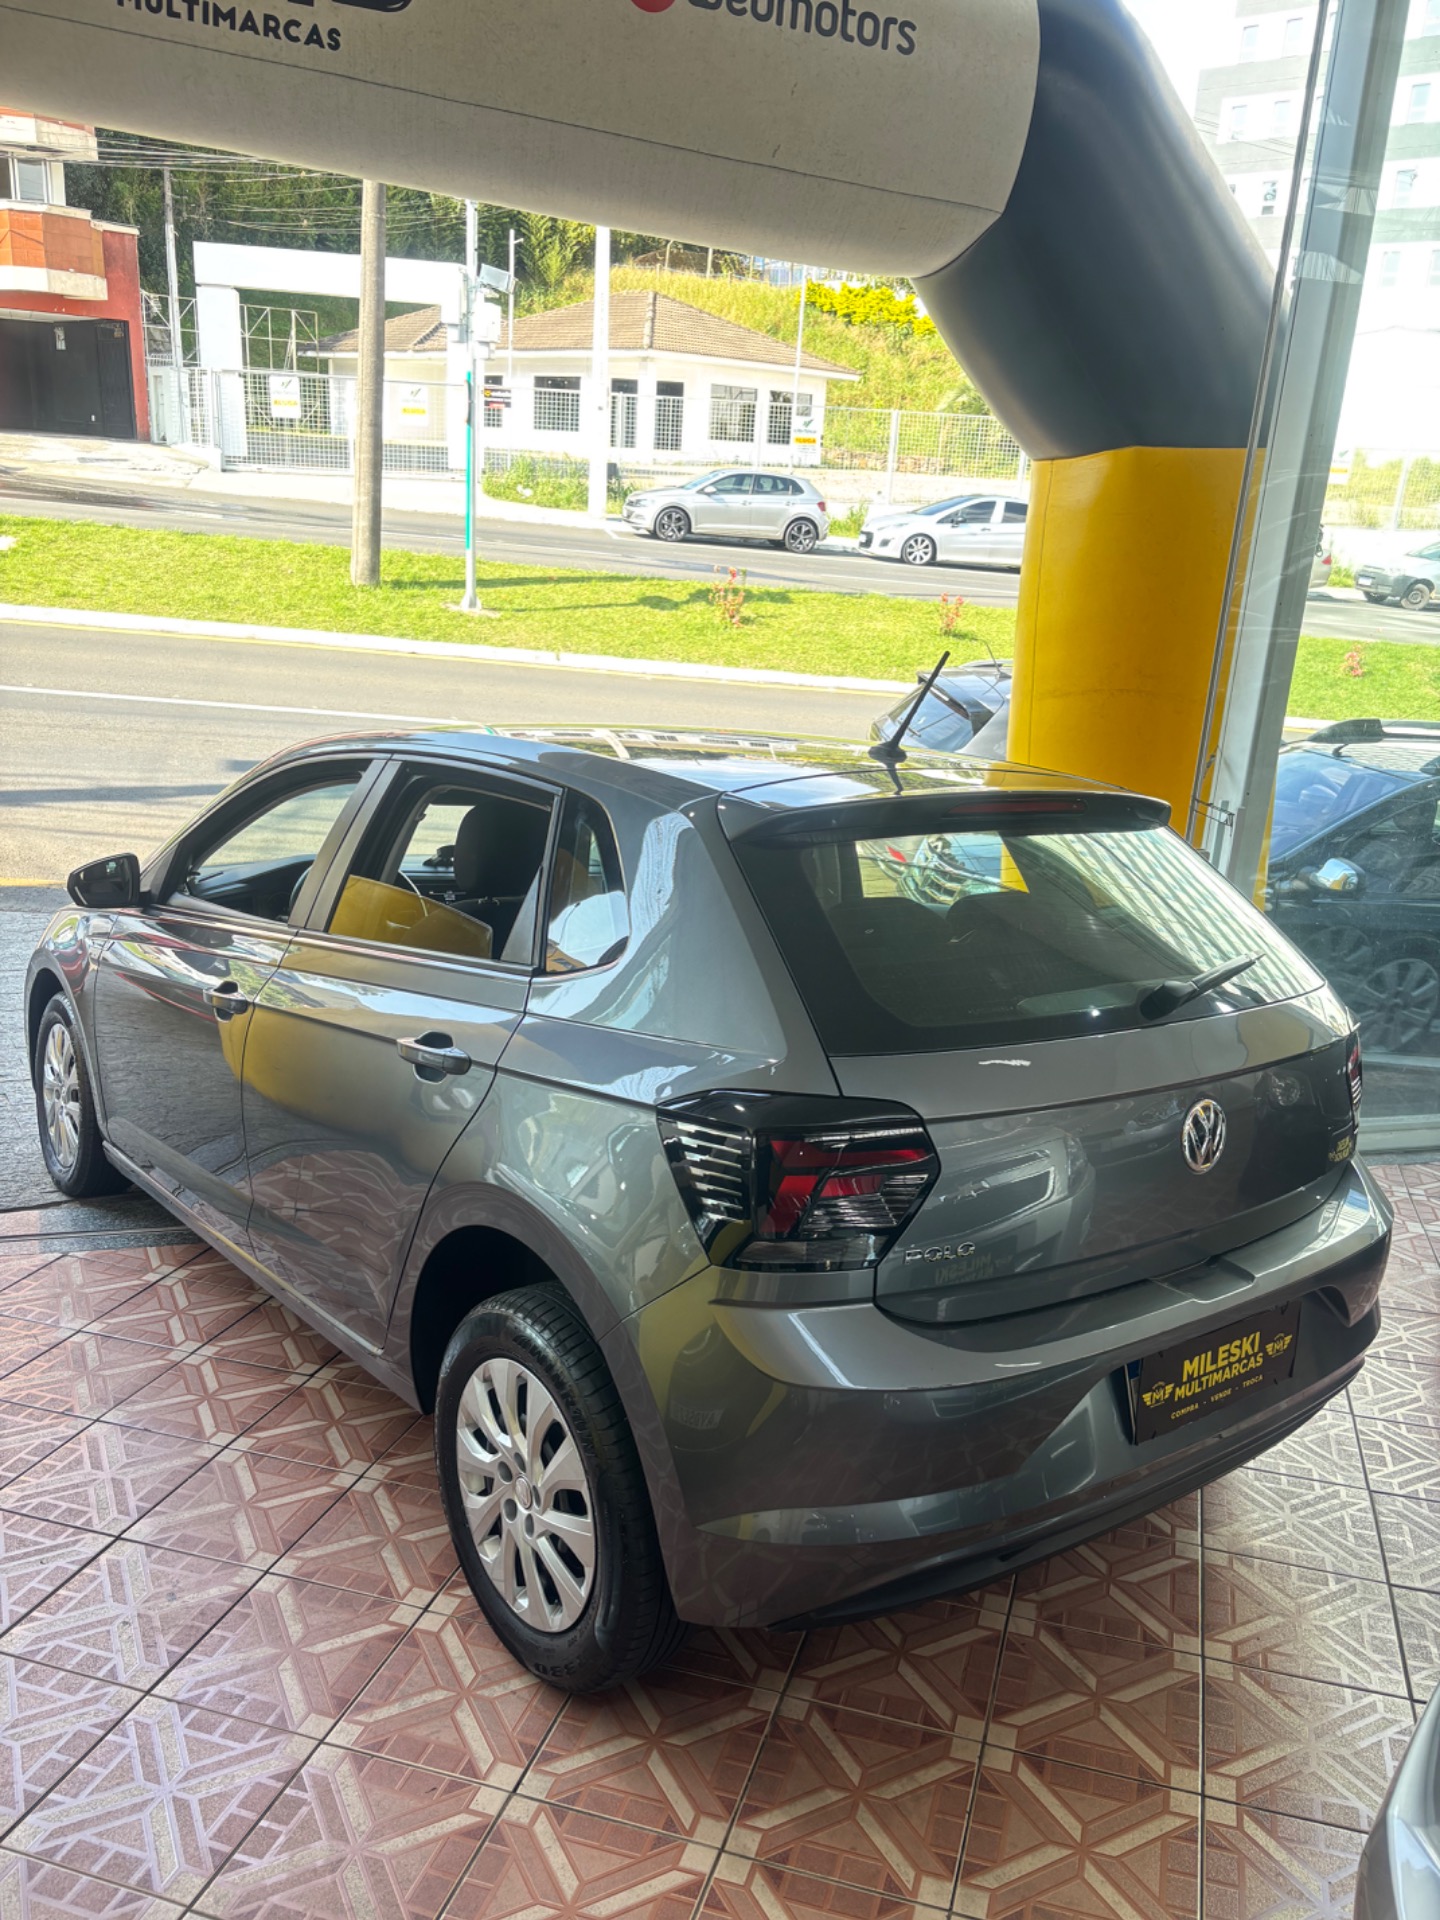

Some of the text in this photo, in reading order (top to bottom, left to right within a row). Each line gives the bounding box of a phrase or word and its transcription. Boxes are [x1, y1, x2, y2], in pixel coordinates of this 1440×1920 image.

[688, 0, 917, 55] motors
[904, 1241, 976, 1265] POLO
[1174, 1352, 1264, 1402] MULTIMARCAS
[1182, 1331, 1260, 1382] MILESKI
